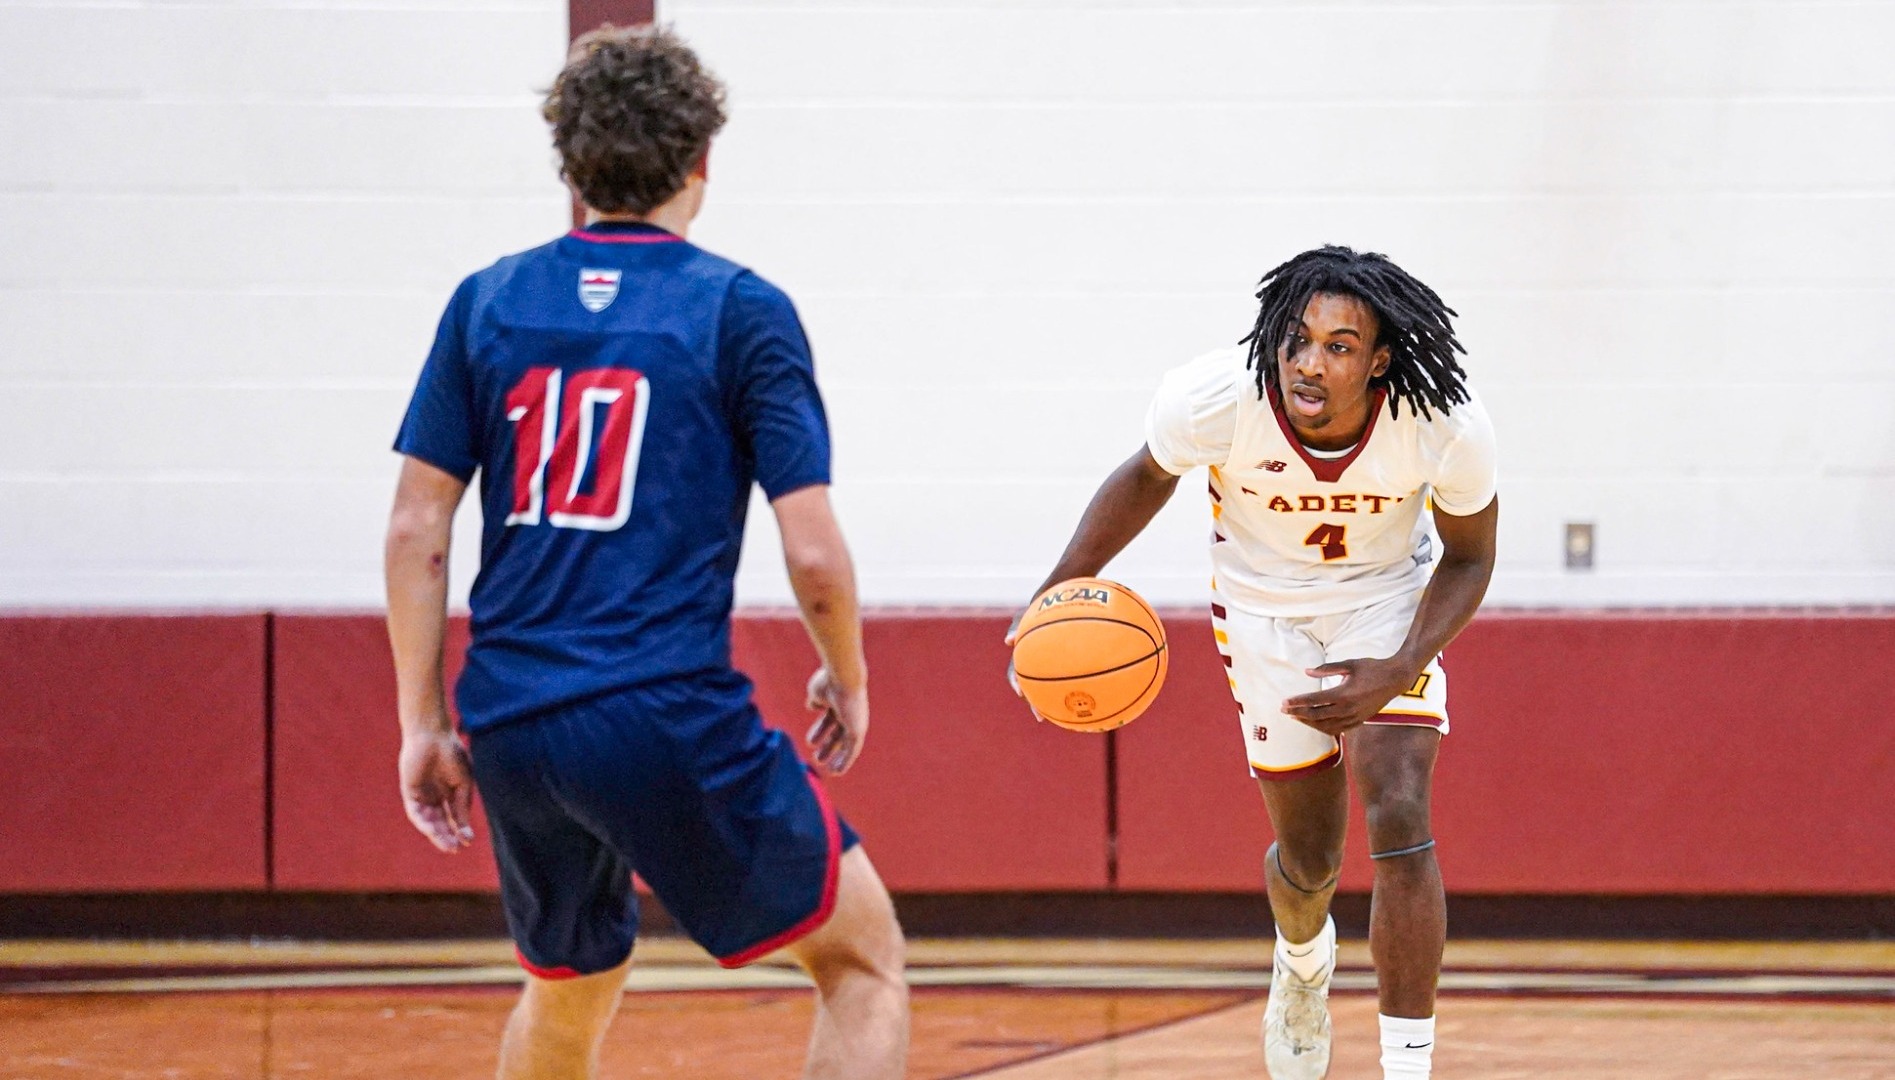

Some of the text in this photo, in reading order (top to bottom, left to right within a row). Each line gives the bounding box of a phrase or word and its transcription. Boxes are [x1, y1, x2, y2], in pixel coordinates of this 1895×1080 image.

[505, 366, 650, 532] 10
[1240, 486, 1404, 514] ADET
[1304, 522, 1347, 561] 4
[1038, 588, 1108, 611] NCAA
